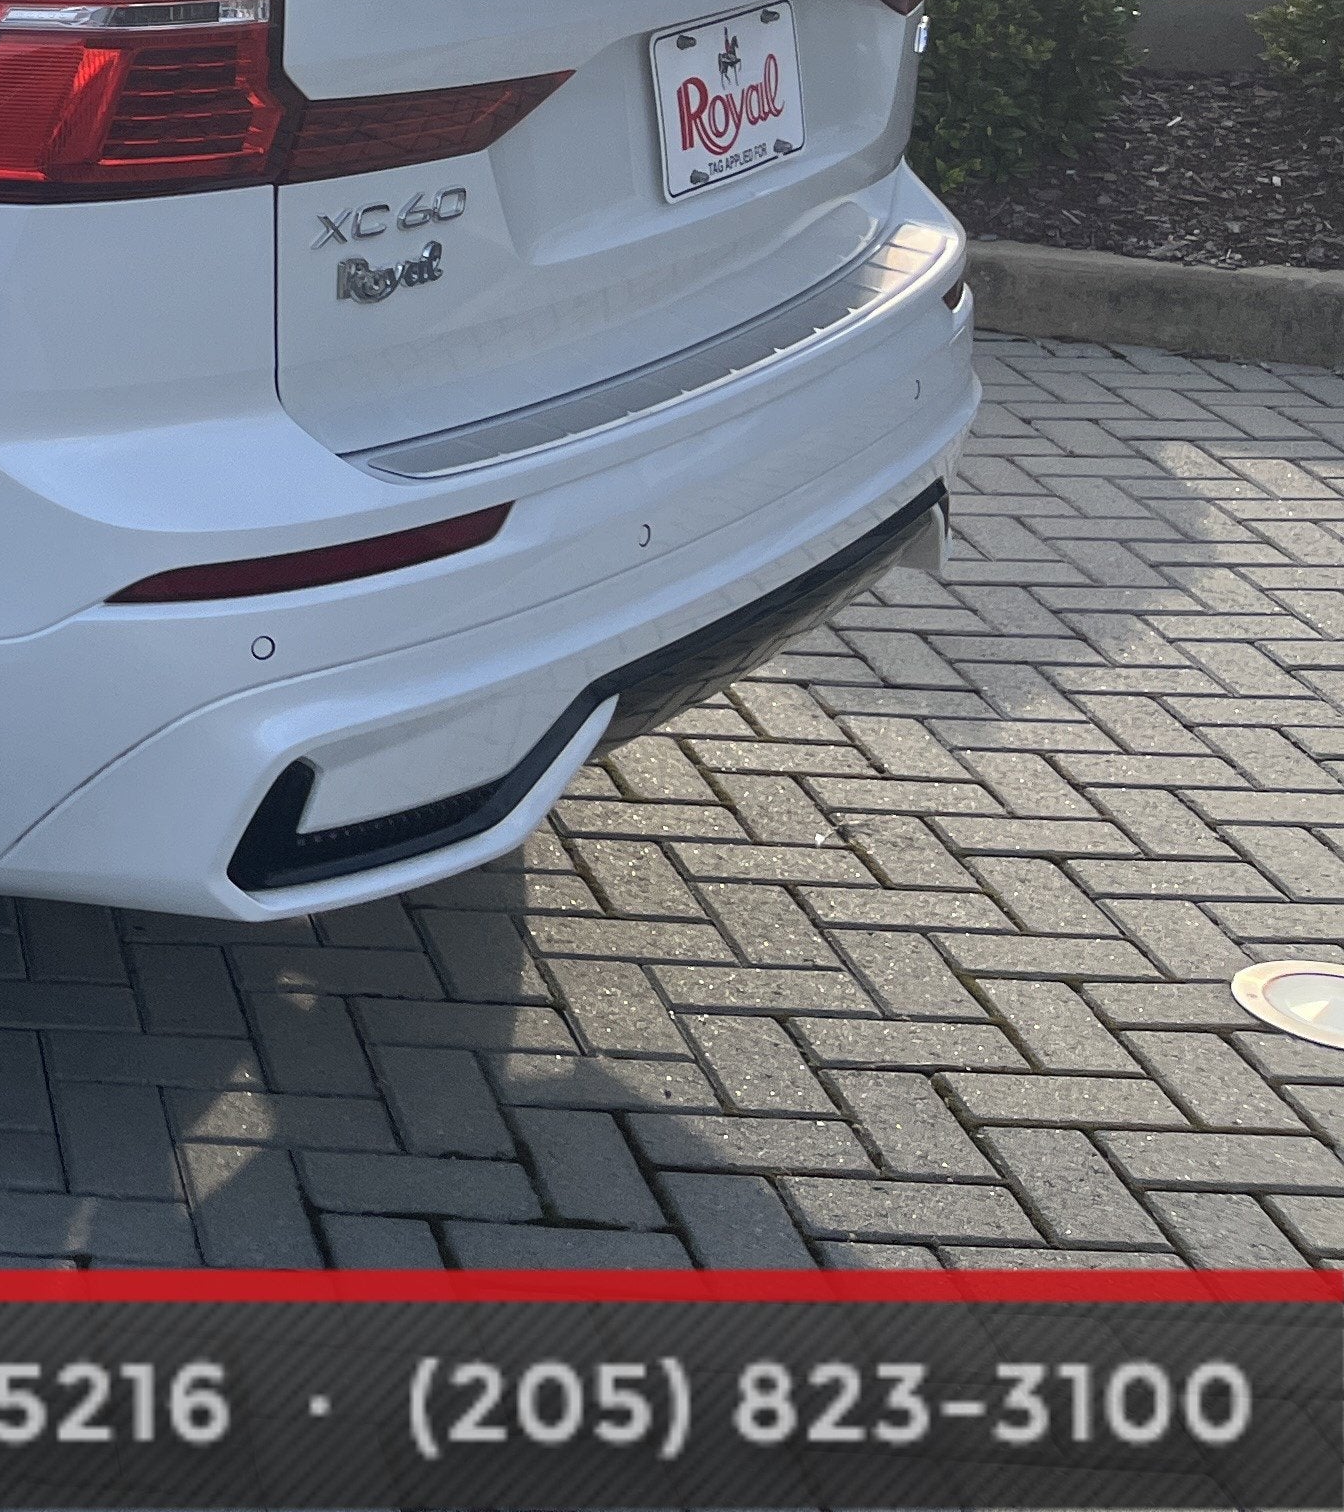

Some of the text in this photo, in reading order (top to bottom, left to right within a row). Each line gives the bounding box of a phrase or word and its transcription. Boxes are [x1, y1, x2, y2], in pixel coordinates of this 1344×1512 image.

[676, 53, 786, 156] Royal
[708, 158, 724, 175] TAG
[336, 240, 444, 304] Royal
